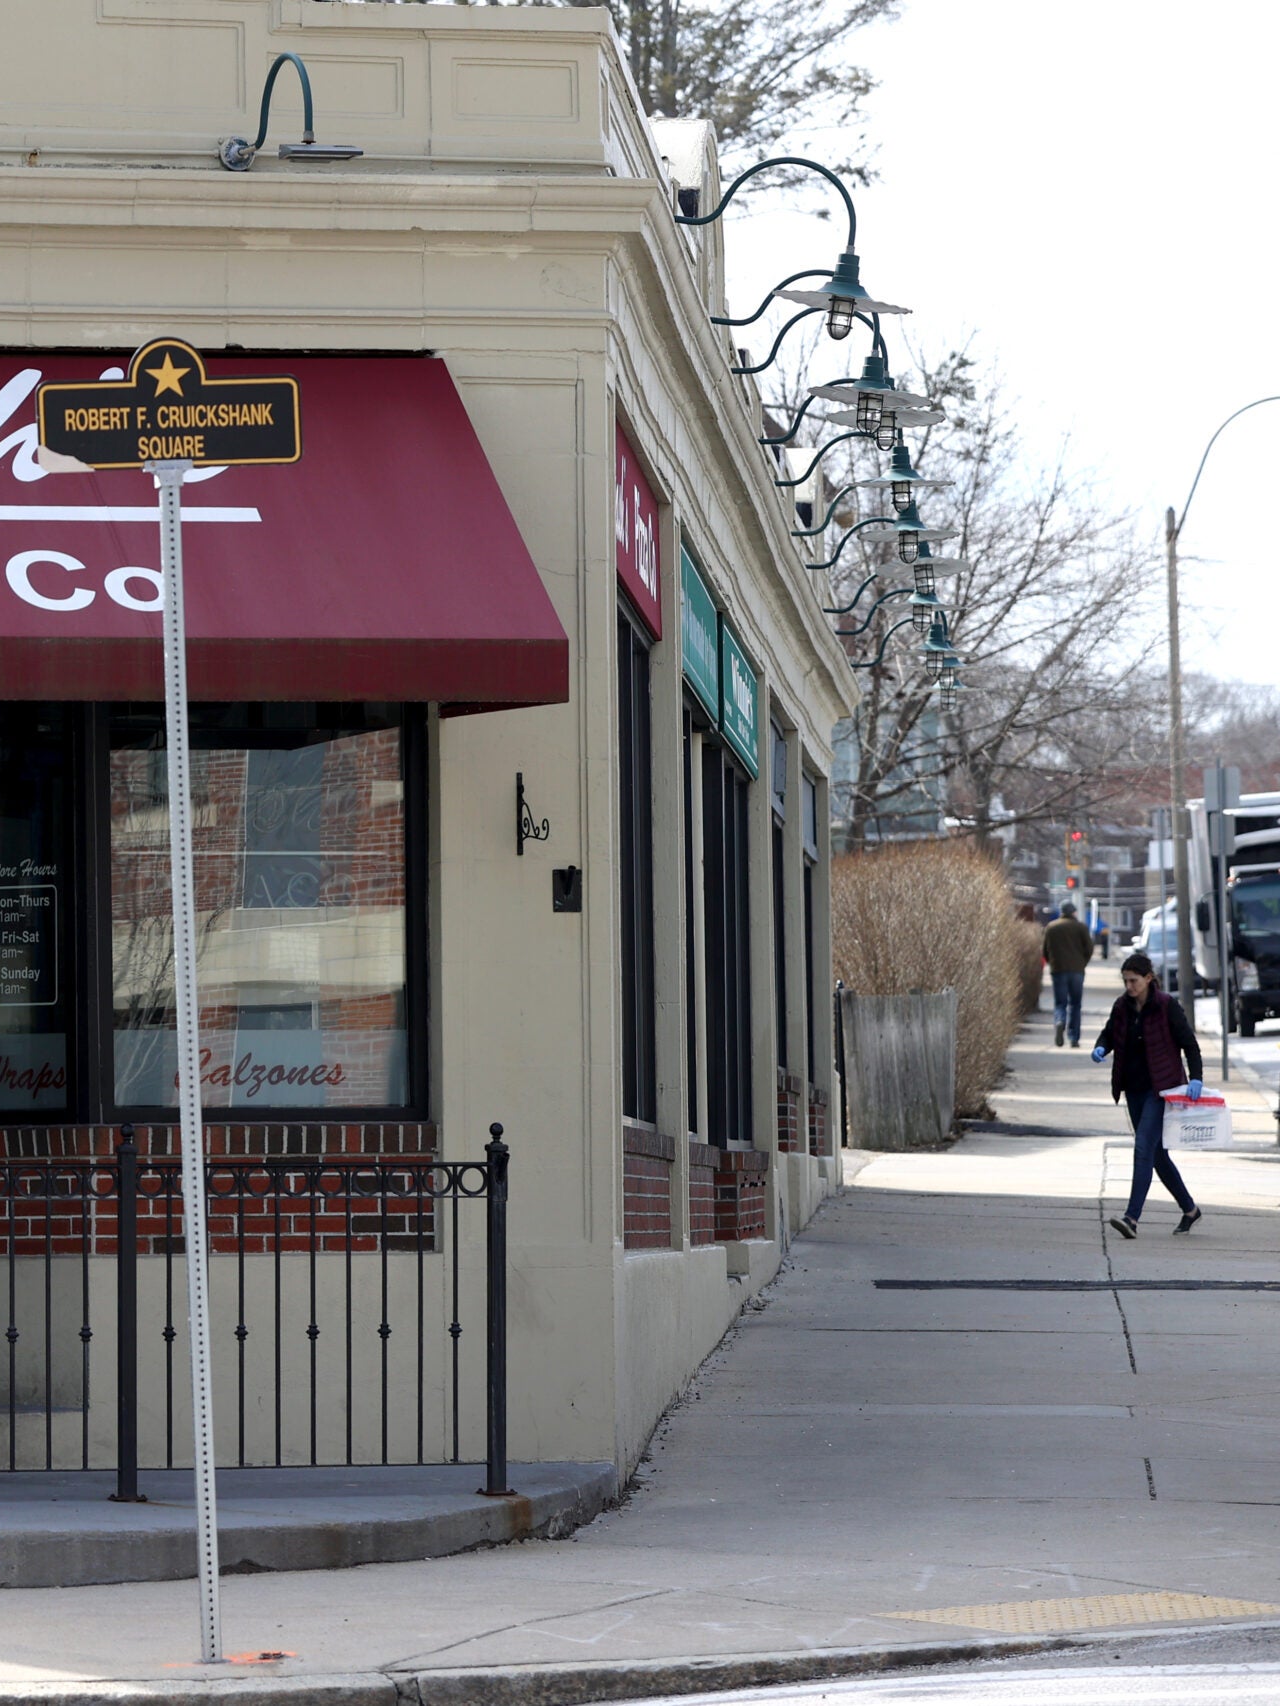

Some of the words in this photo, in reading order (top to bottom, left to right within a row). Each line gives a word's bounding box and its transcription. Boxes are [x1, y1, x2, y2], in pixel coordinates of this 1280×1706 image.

[65, 407, 131, 432] ROBERT
[136, 406, 151, 430] F.
[156, 403, 274, 429] CRUICKSHANK
[138, 435, 205, 460] SQUARE
[20, 858, 58, 878] Hours
[0, 966, 41, 982] Sunday
